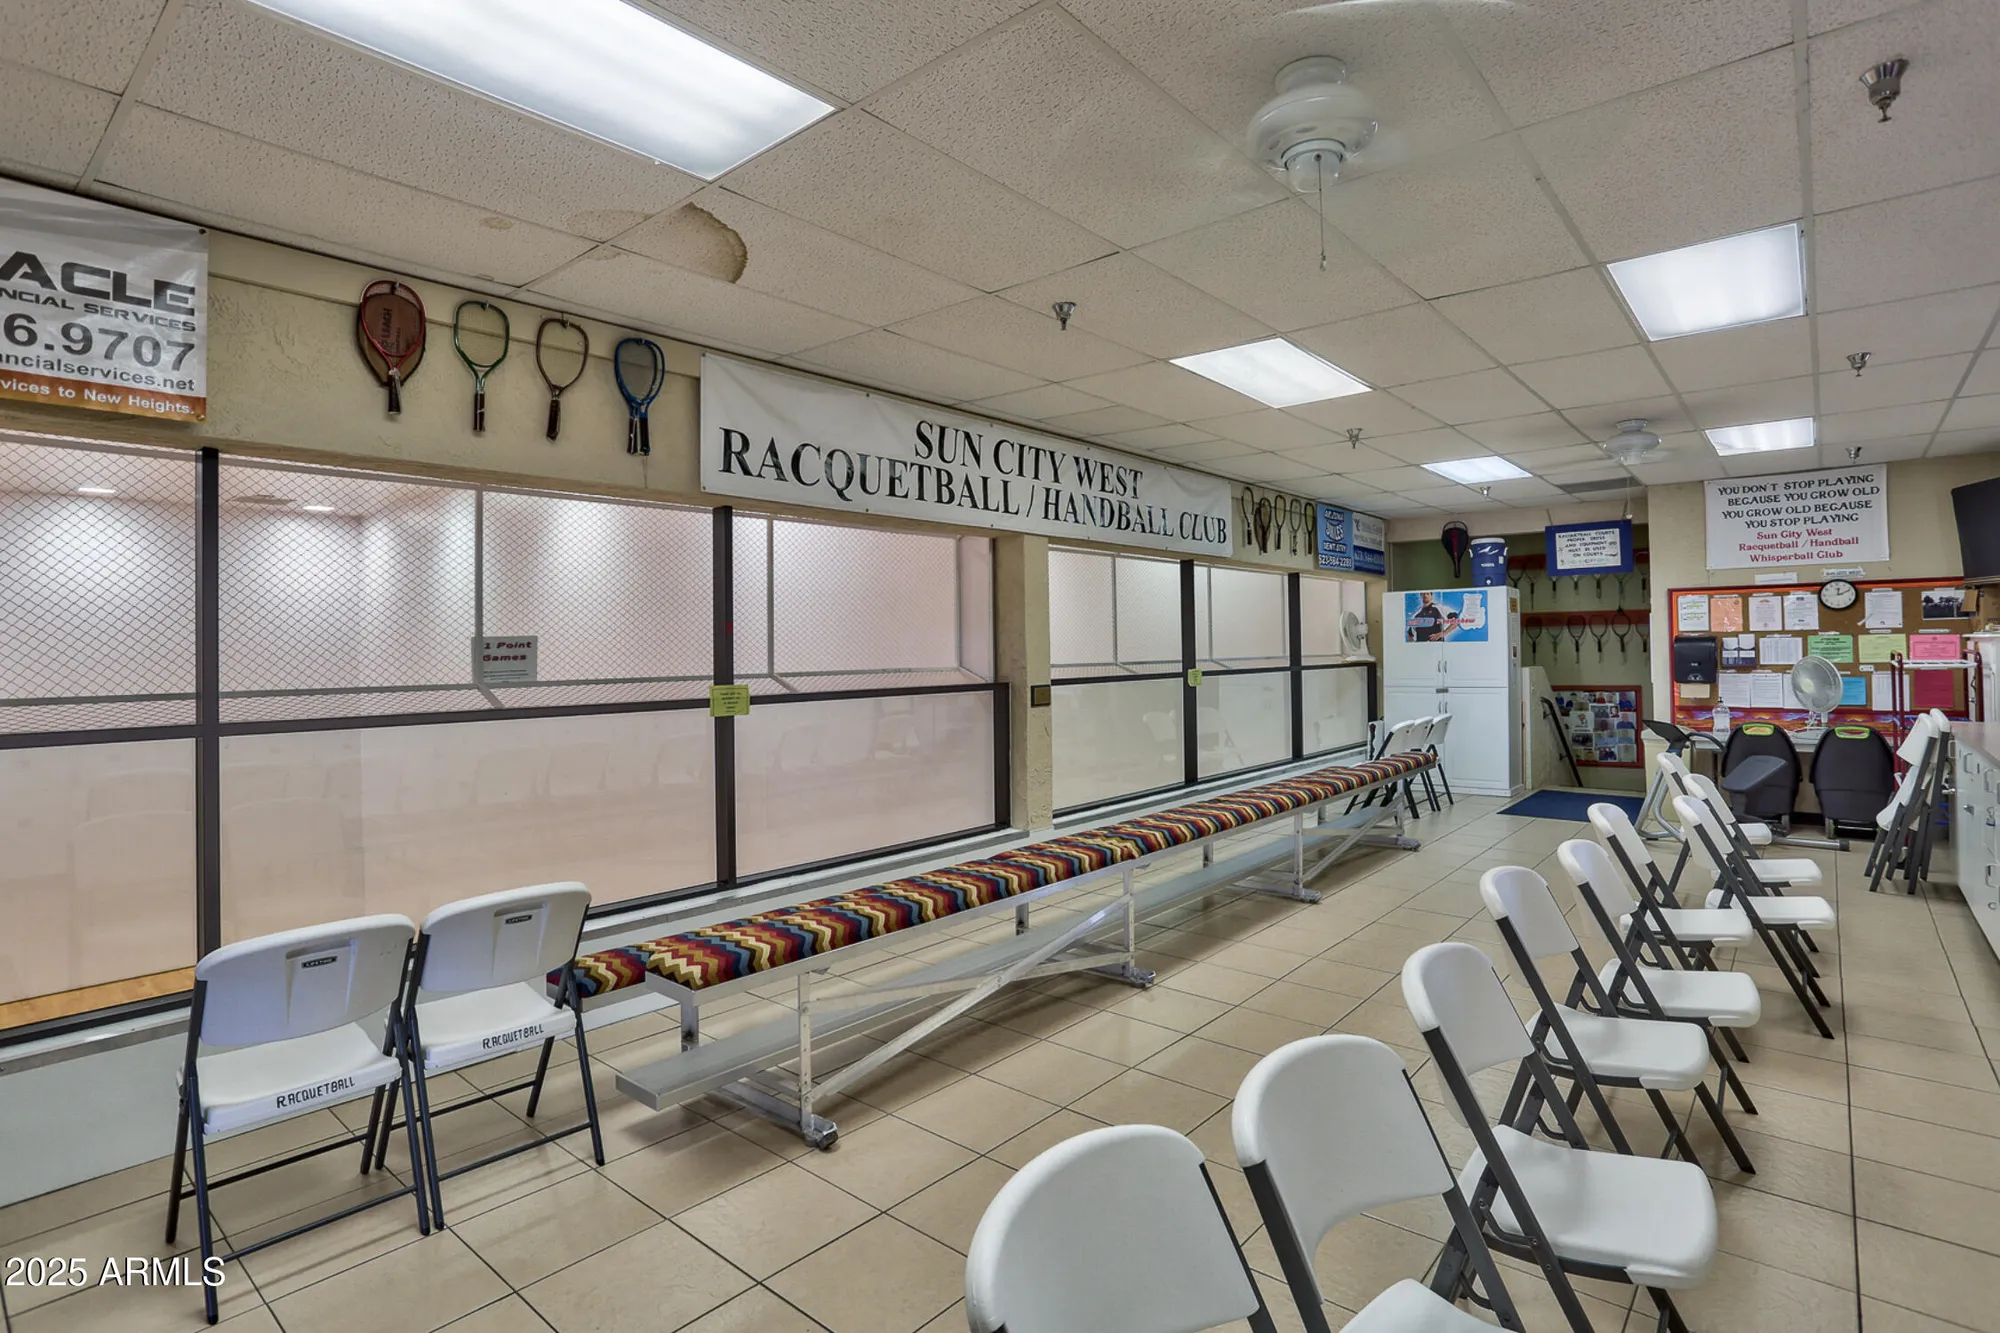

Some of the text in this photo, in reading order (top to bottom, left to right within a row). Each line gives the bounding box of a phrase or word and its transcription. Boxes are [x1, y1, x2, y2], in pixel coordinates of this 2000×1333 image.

[0, 251, 195, 316] ACLE
[84, 303, 196, 332] SERVICES
[3, 313, 195, 372] 6.9707
[0, 379, 195, 415] vices to New Heights.
[913, 419, 1144, 500] SUN CITY WEST
[718, 427, 1021, 516] RACQUETBALL
[1043, 486, 1175, 538] HANDBALL
[1178, 511, 1228, 544] CLUB
[1718, 474, 1875, 495] YOU DON'T STOP PLAYING
[1784, 492, 1808, 501] YOU
[1810, 489, 1850, 500] GROW
[1852, 486, 1880, 497] OLD
[1722, 510, 1744, 519] YOU
[1746, 507, 1782, 518] GROW
[1786, 505, 1811, 514] OLD
[1745, 513, 1860, 529] YOU STOP PLAYING
[1739, 540, 1799, 552] Racquetball
[1810, 537, 1859, 547] Handball
[1756, 531, 1778, 540] Sun
[1806, 528, 1833, 537] West
[1749, 552, 1814, 563] Whisperball
[496, 641, 532, 649] Point
[482, 1024, 545, 1050] RACQUETBALL
[276, 1076, 356, 1109] RACQUETBALL
